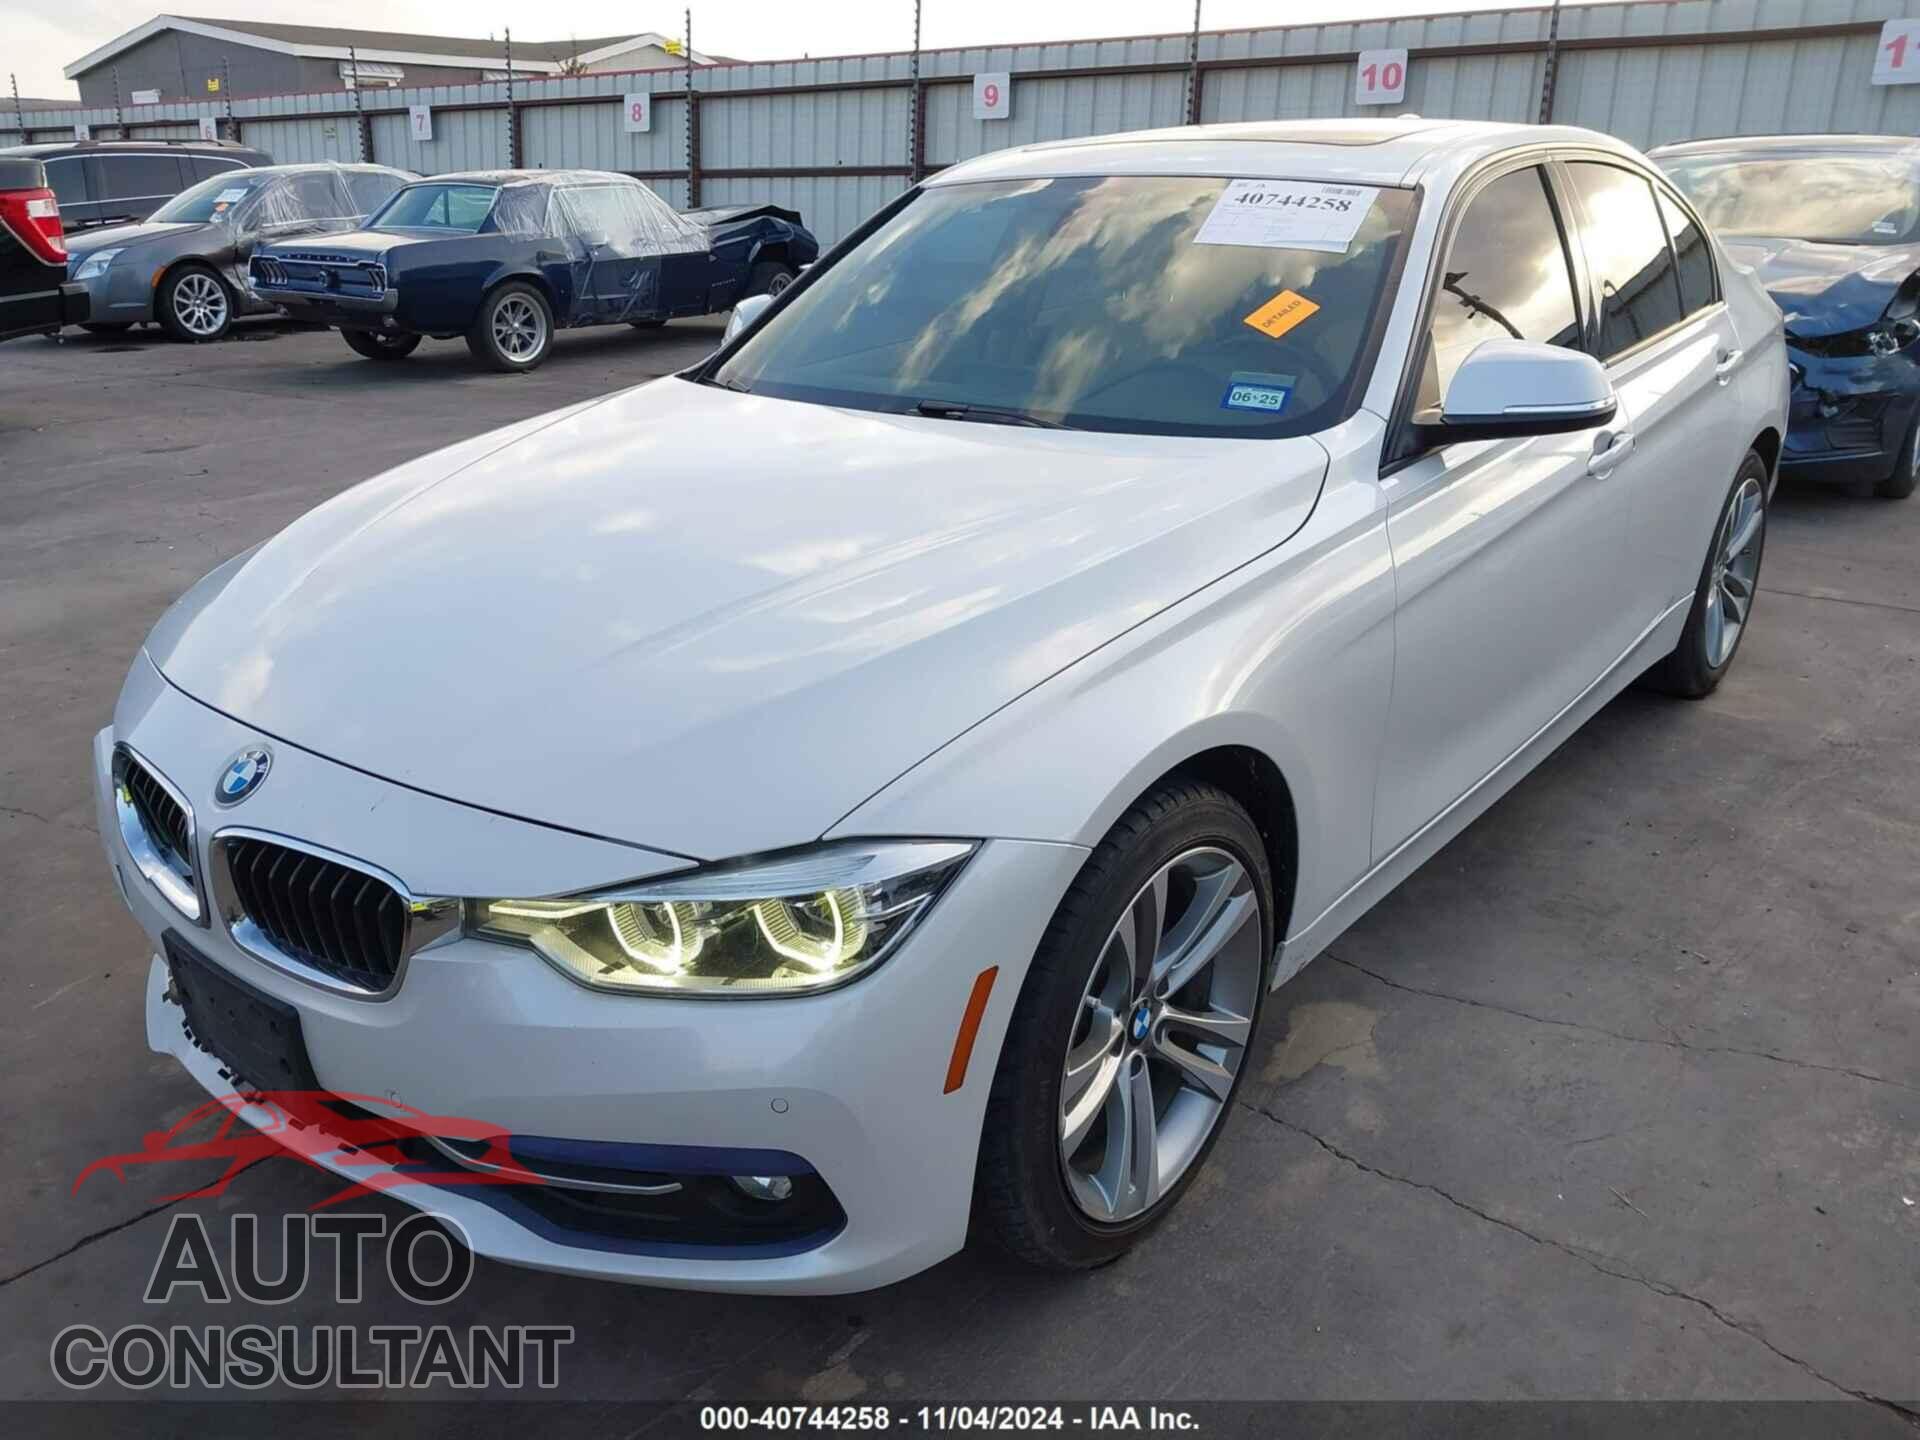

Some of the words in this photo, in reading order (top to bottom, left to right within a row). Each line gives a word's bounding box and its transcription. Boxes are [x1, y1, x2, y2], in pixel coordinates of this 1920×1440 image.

[1886, 33, 1920, 68] 1
[1362, 62, 1402, 91] 10
[984, 84, 998, 107] 9
[415, 113, 425, 131] 7
[632, 103, 642, 122] 8
[1235, 192, 1352, 212] 40744258
[1262, 300, 1301, 329] DETAILED
